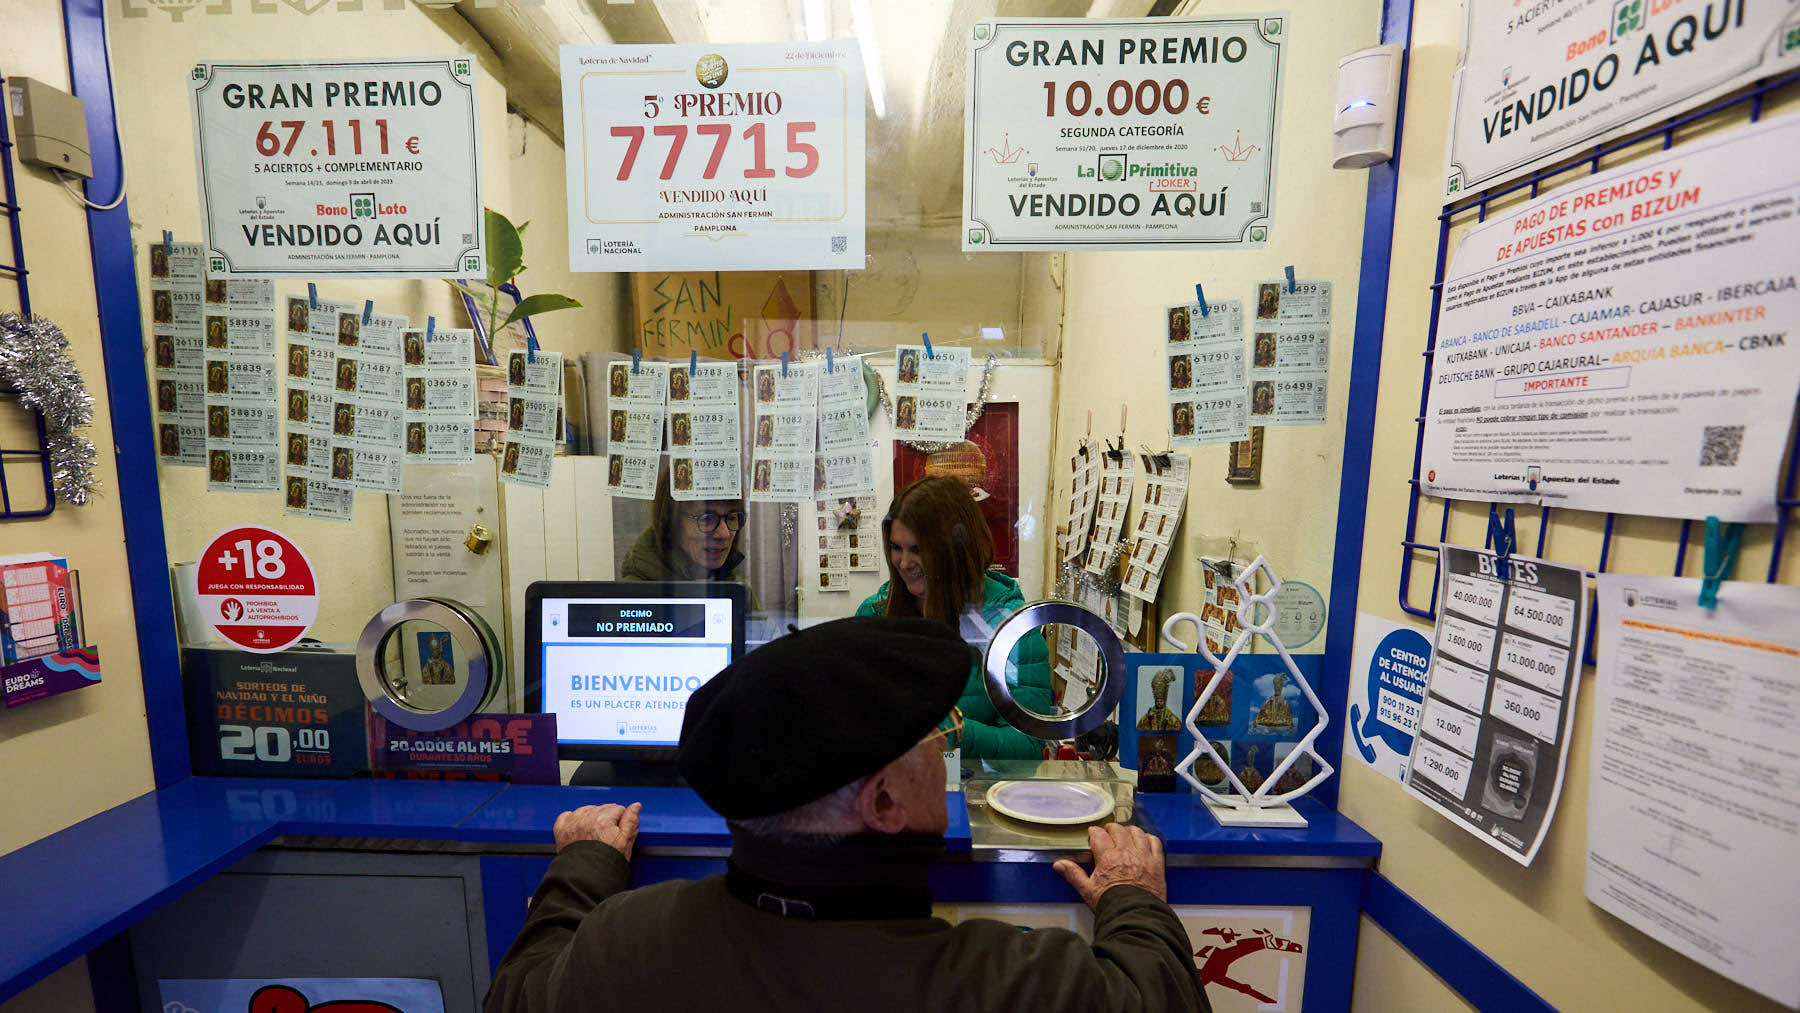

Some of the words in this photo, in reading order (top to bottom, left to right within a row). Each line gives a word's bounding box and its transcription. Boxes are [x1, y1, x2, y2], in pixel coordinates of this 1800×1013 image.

[1006, 39, 1104, 66] GRAN
[1120, 36, 1248, 64] PREMIO
[1566, 30, 1607, 62] Bono
[222, 83, 312, 109] GRAN
[325, 81, 442, 108] PREMIO
[1043, 78, 1190, 117] 10.000
[1196, 96, 1210, 114] €
[1482, 53, 1620, 144] VENDIDO
[674, 92, 782, 118] PREMIO
[256, 119, 389, 156] 67.111
[405, 136, 420, 155] €
[1060, 127, 1116, 138] SEGUNDA
[1118, 125, 1184, 137] CATEGORÍA
[610, 122, 820, 181] 77715
[254, 164, 261, 173] 5
[263, 163, 314, 173] ACIERTOS
[324, 161, 423, 173] COMPLEMENTARIO
[1078, 165, 1094, 178] La
[1129, 162, 1198, 178] Primitiva
[1156, 179, 1190, 188] JOKER
[659, 189, 726, 203] VENDIDO
[730, 186, 767, 204] AQUÍ
[1008, 193, 1140, 217] VENDIDO
[1151, 186, 1229, 218] AQUÍ
[1514, 210, 1546, 235] PAGO
[1550, 201, 1569, 221] DE
[1572, 170, 1664, 214] PREMIOS
[316, 204, 348, 216] Bono
[378, 203, 407, 216] Loto
[658, 210, 726, 219] ADMINISTRACIÓN
[242, 224, 362, 247] VENDIDO
[374, 216, 441, 246] AQUÍ
[1496, 246, 1512, 262] DE
[1514, 219, 1587, 257] APUESTAS
[1592, 212, 1624, 232] con
[1631, 186, 1702, 222] BIZUM
[654, 271, 721, 314] SAN
[1512, 301, 1535, 317] BBVA
[1545, 286, 1614, 310] CAIXABANK
[1440, 338, 1467, 350] ABANCA
[1472, 331, 1500, 342] BANCO
[1500, 326, 1512, 337] DE
[1514, 317, 1560, 336] SABADELL
[1639, 292, 1703, 314] CAJASUR
[1717, 276, 1797, 302] IBERCAJA
[643, 304, 732, 349] FERMIN
[1446, 347, 1488, 364] KUTXABANK
[1495, 340, 1531, 356] UNICAJA
[1540, 333, 1576, 349] BANCO
[1579, 322, 1658, 344] SANTANDER
[1674, 306, 1767, 332] BANKINTER
[1280, 334, 1315, 342] 56499
[1194, 353, 1230, 363] 61790
[1439, 371, 1474, 384] DEUTSCHE
[1474, 368, 1495, 380] BANK
[1504, 362, 1536, 376] GRUPO
[1612, 346, 1665, 364] ARQUIA
[1739, 332, 1786, 351] CBNK
[360, 363, 391, 374] 71487
[428, 380, 458, 388] 03656
[1524, 376, 1589, 392] IMPORTANTE
[692, 414, 724, 423] 40783
[1542, 476, 1574, 484] Apuestas
[1578, 476, 1590, 484] del
[218, 539, 286, 580] +18
[1453, 590, 1492, 608] 40.000.000
[620, 610, 653, 618] DECIMO
[1514, 605, 1564, 626] 64.500.000
[596, 622, 614, 632] NO
[616, 622, 674, 633] PREMIADO
[1447, 633, 1482, 652] 3.600.000
[1378, 656, 1391, 670] DE
[1390, 648, 1427, 668] CENTRO
[1506, 652, 1556, 676] 13.000.000
[6, 674, 30, 686] EURO
[6, 677, 44, 694] DREAMS
[236, 682, 288, 692] SORTEOS
[291, 684, 306, 692] DE
[571, 675, 701, 692] BIENVENIDO
[1380, 672, 1392, 684] AL
[1392, 676, 1423, 696] USUAR
[216, 690, 266, 702] NAVIDAD
[271, 693, 278, 702] Y
[282, 694, 295, 702] EL
[298, 693, 327, 704] NIÑO
[571, 700, 582, 708] ES
[586, 700, 601, 708] UN
[604, 700, 641, 709] PLACER
[645, 701, 687, 710] ATENDE
[1382, 696, 1396, 708] 900
[1398, 702, 1404, 711] 11
[1406, 706, 1415, 716] 23
[218, 702, 329, 724] DÉCIMOS
[1392, 713, 1402, 724] 96
[1402, 718, 1412, 728] 23
[1504, 700, 1541, 722] 360.000
[1436, 718, 1462, 736] 12.000
[458, 741, 477, 753] AL
[480, 741, 511, 754] MES
[1423, 756, 1460, 782] 1.290.000
